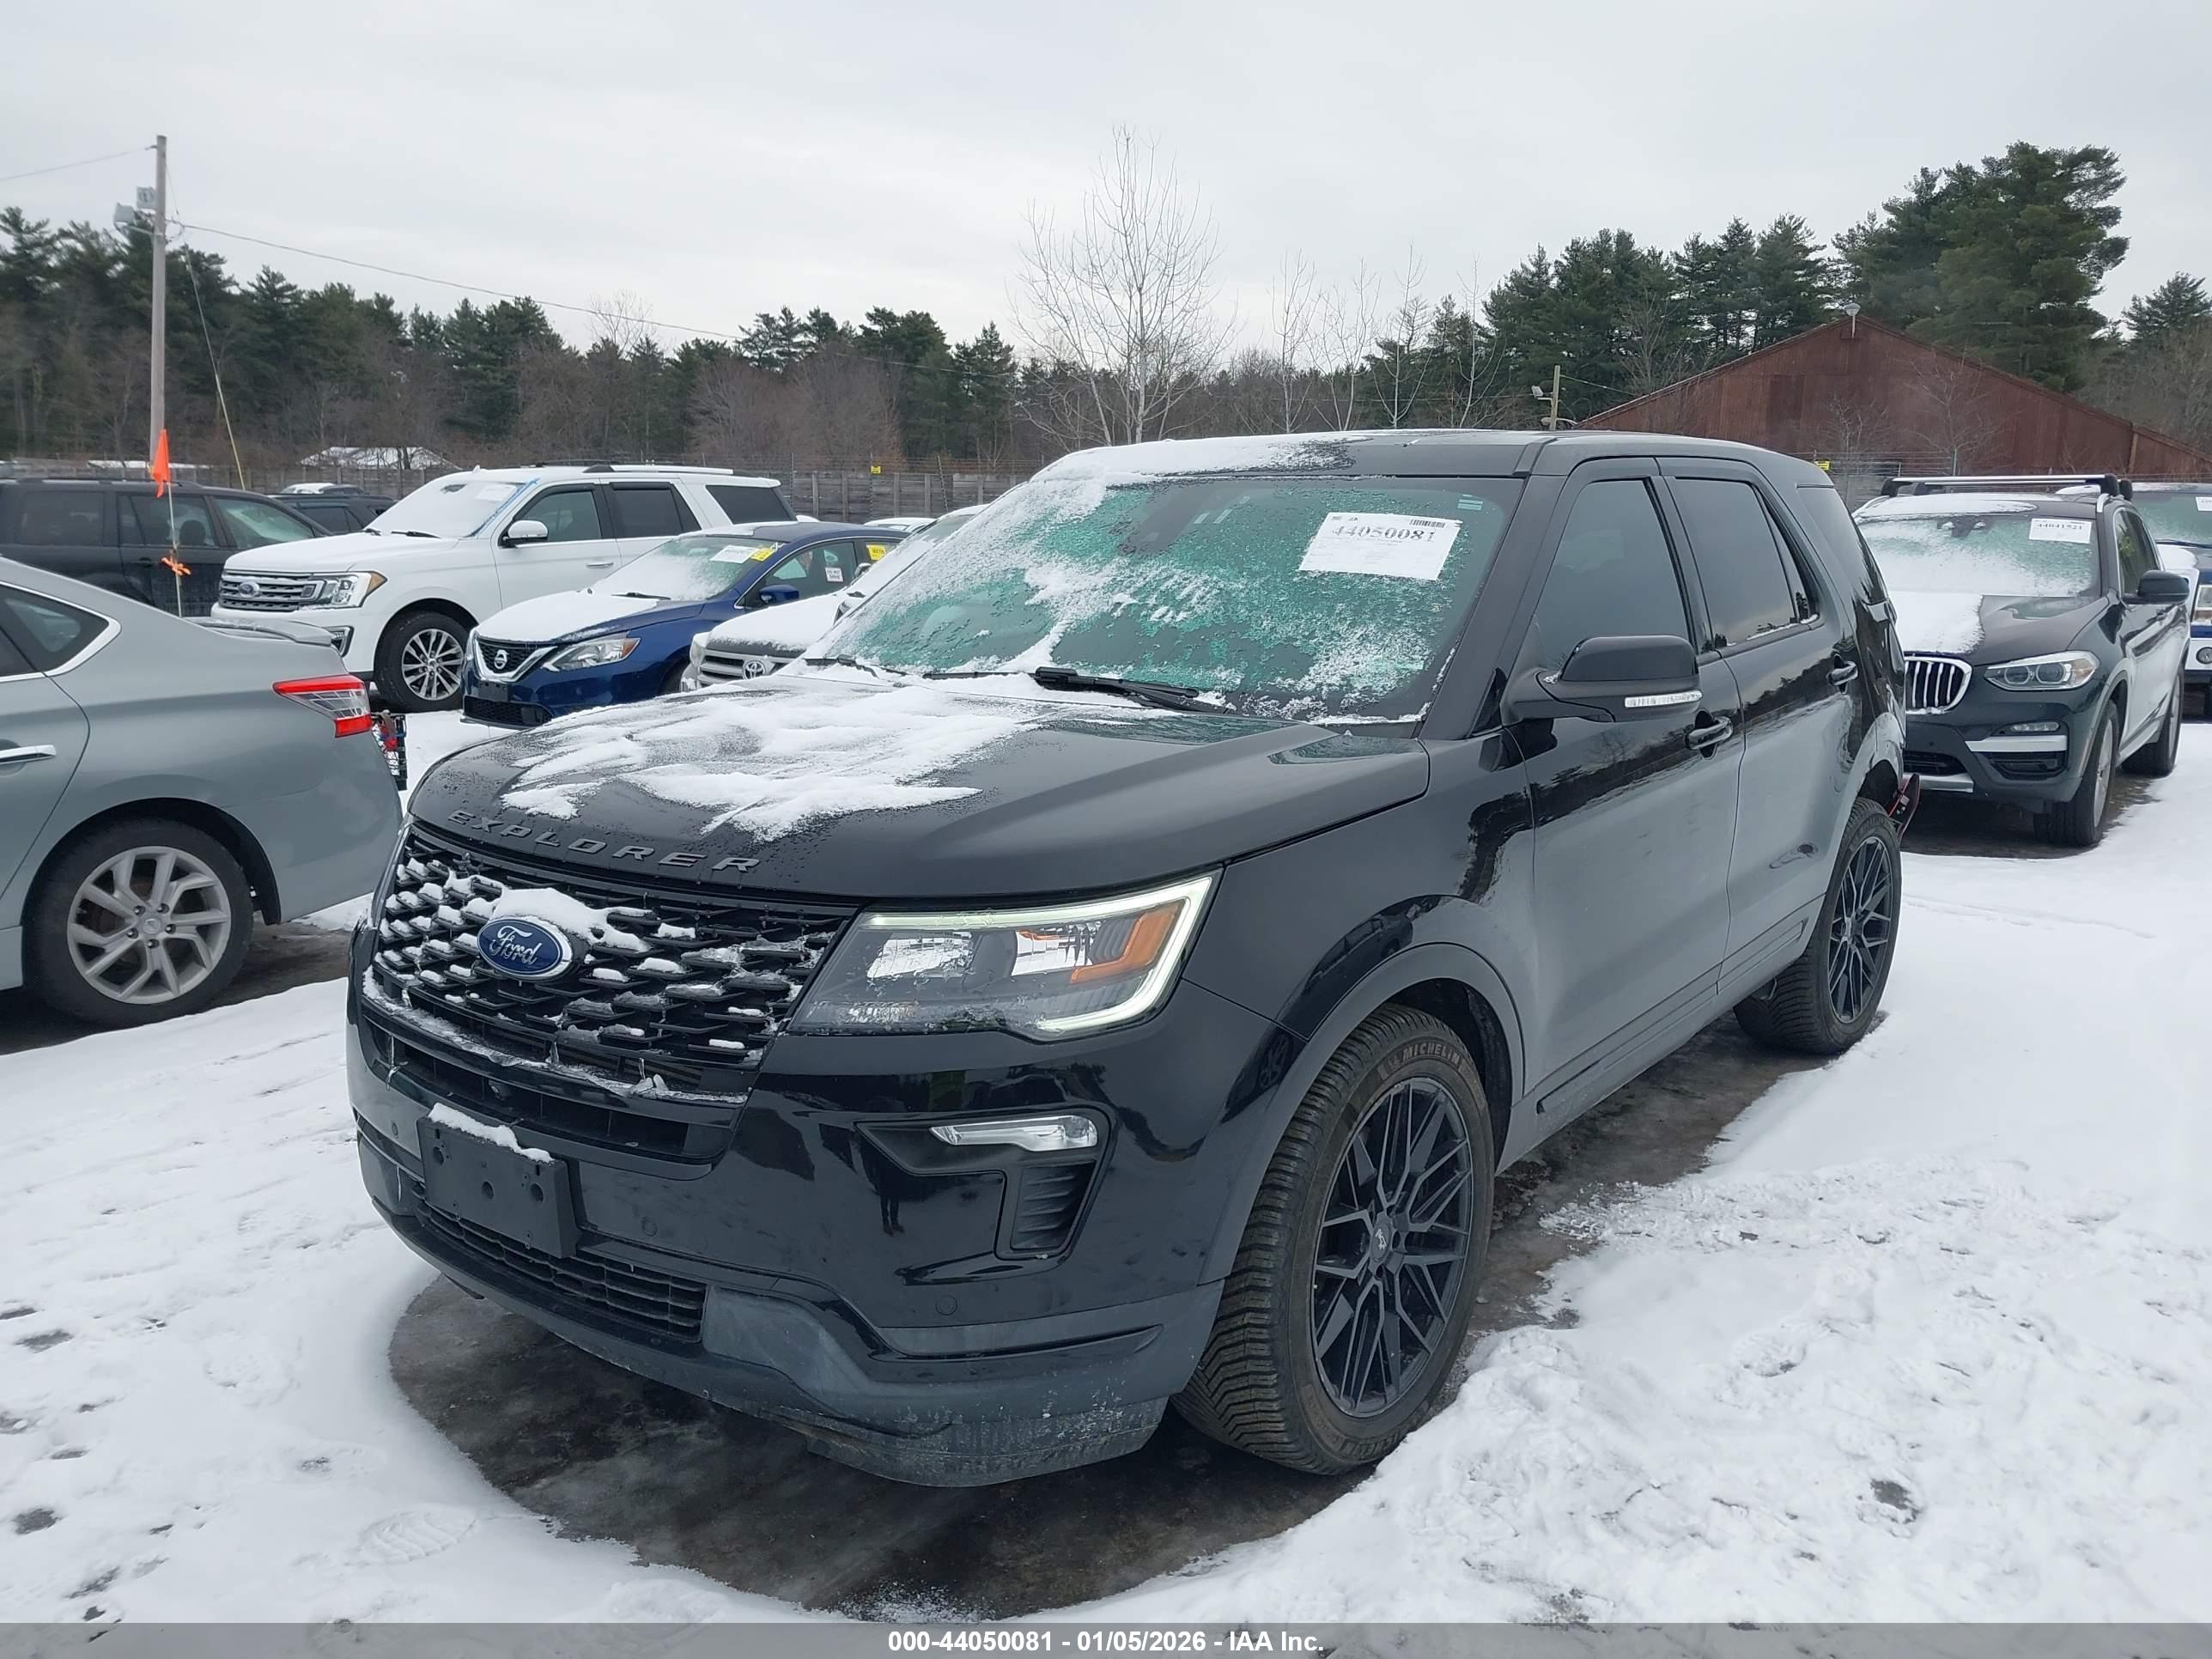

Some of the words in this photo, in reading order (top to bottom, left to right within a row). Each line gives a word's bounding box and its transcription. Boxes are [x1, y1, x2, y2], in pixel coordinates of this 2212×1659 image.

[1332, 525, 1437, 543] 44050081
[447, 810, 760, 872] EXPLORER
[489, 924, 544, 965] Ford
[1403, 1042, 1461, 1066] MICHELIN
